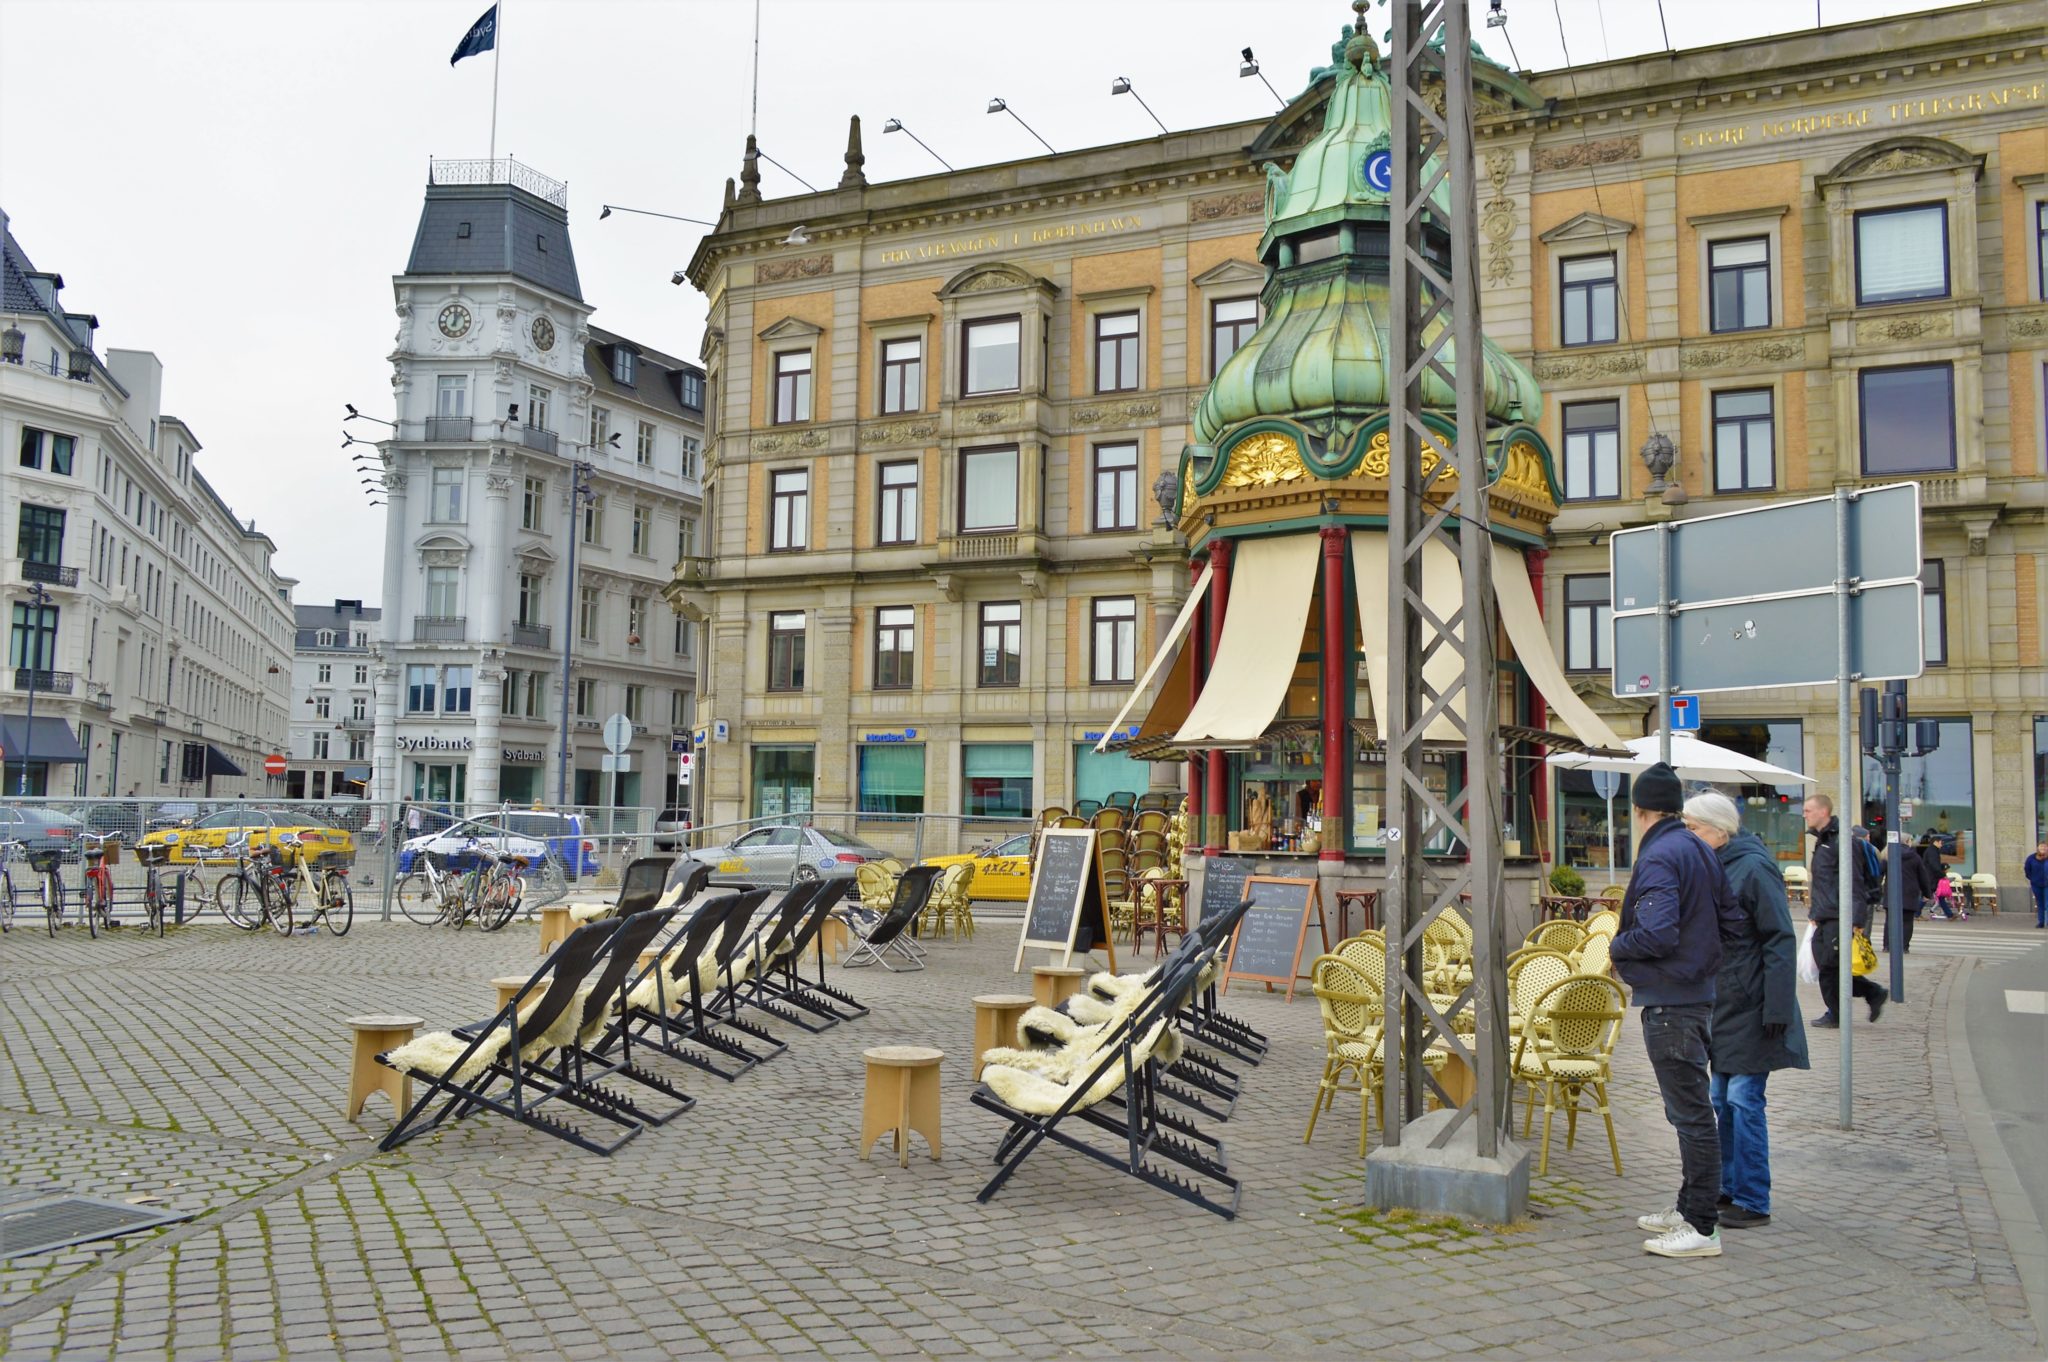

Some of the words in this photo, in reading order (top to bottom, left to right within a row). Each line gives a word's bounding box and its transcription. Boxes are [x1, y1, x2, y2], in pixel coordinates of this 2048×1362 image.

[1682, 125, 1750, 147] STORE
[1762, 108, 1873, 137] NORDISKE
[395, 736, 473, 752] Sydbank
[866, 732, 905, 742] Nordea
[503, 748, 546, 762] Sydbank
